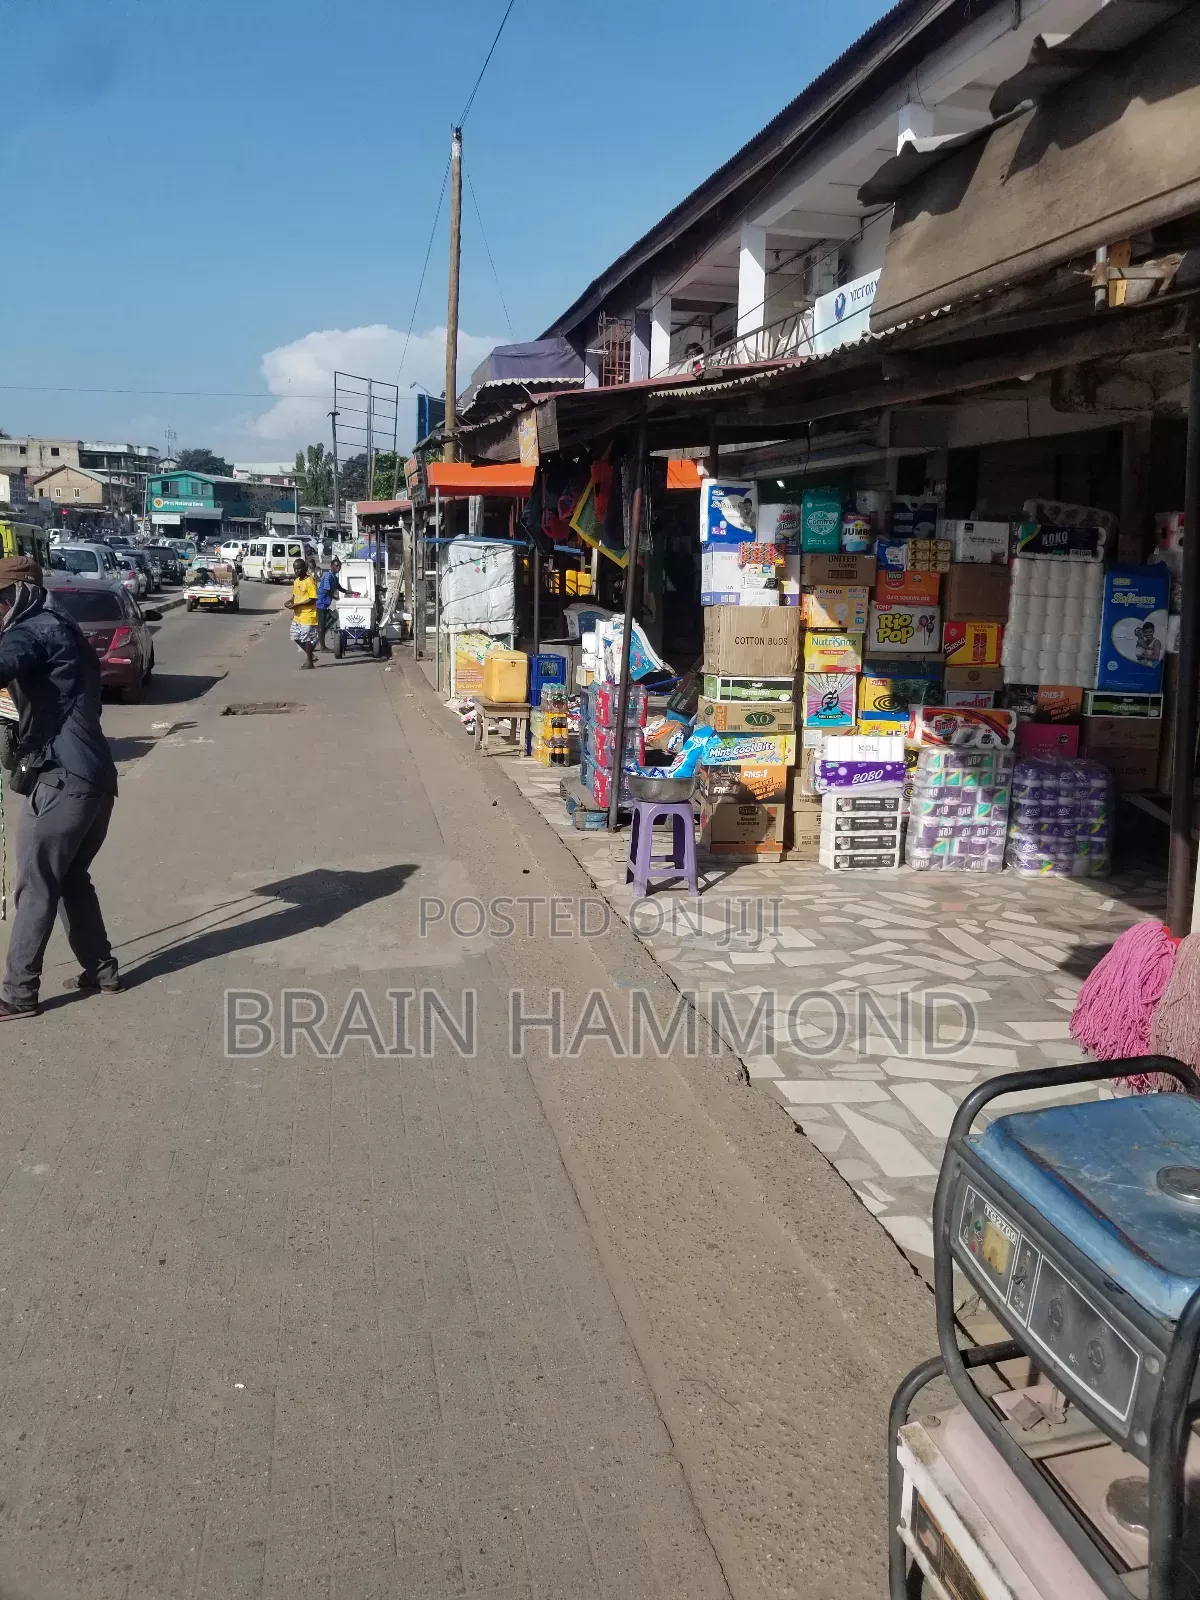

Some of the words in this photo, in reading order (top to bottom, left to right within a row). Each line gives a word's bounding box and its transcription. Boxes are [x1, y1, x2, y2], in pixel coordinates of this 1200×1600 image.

[1042, 531, 1069, 546] KOKO
[828, 555, 857, 563] UNITED
[734, 636, 765, 646] COTTON
[767, 637, 788, 646] BUDS
[944, 637, 966, 654] Sasso
[709, 747, 732, 758] Mint
[743, 769, 769, 778] FMS-1
[851, 769, 884, 784] BOBO
[985, 1205, 1016, 1242] TG2700
